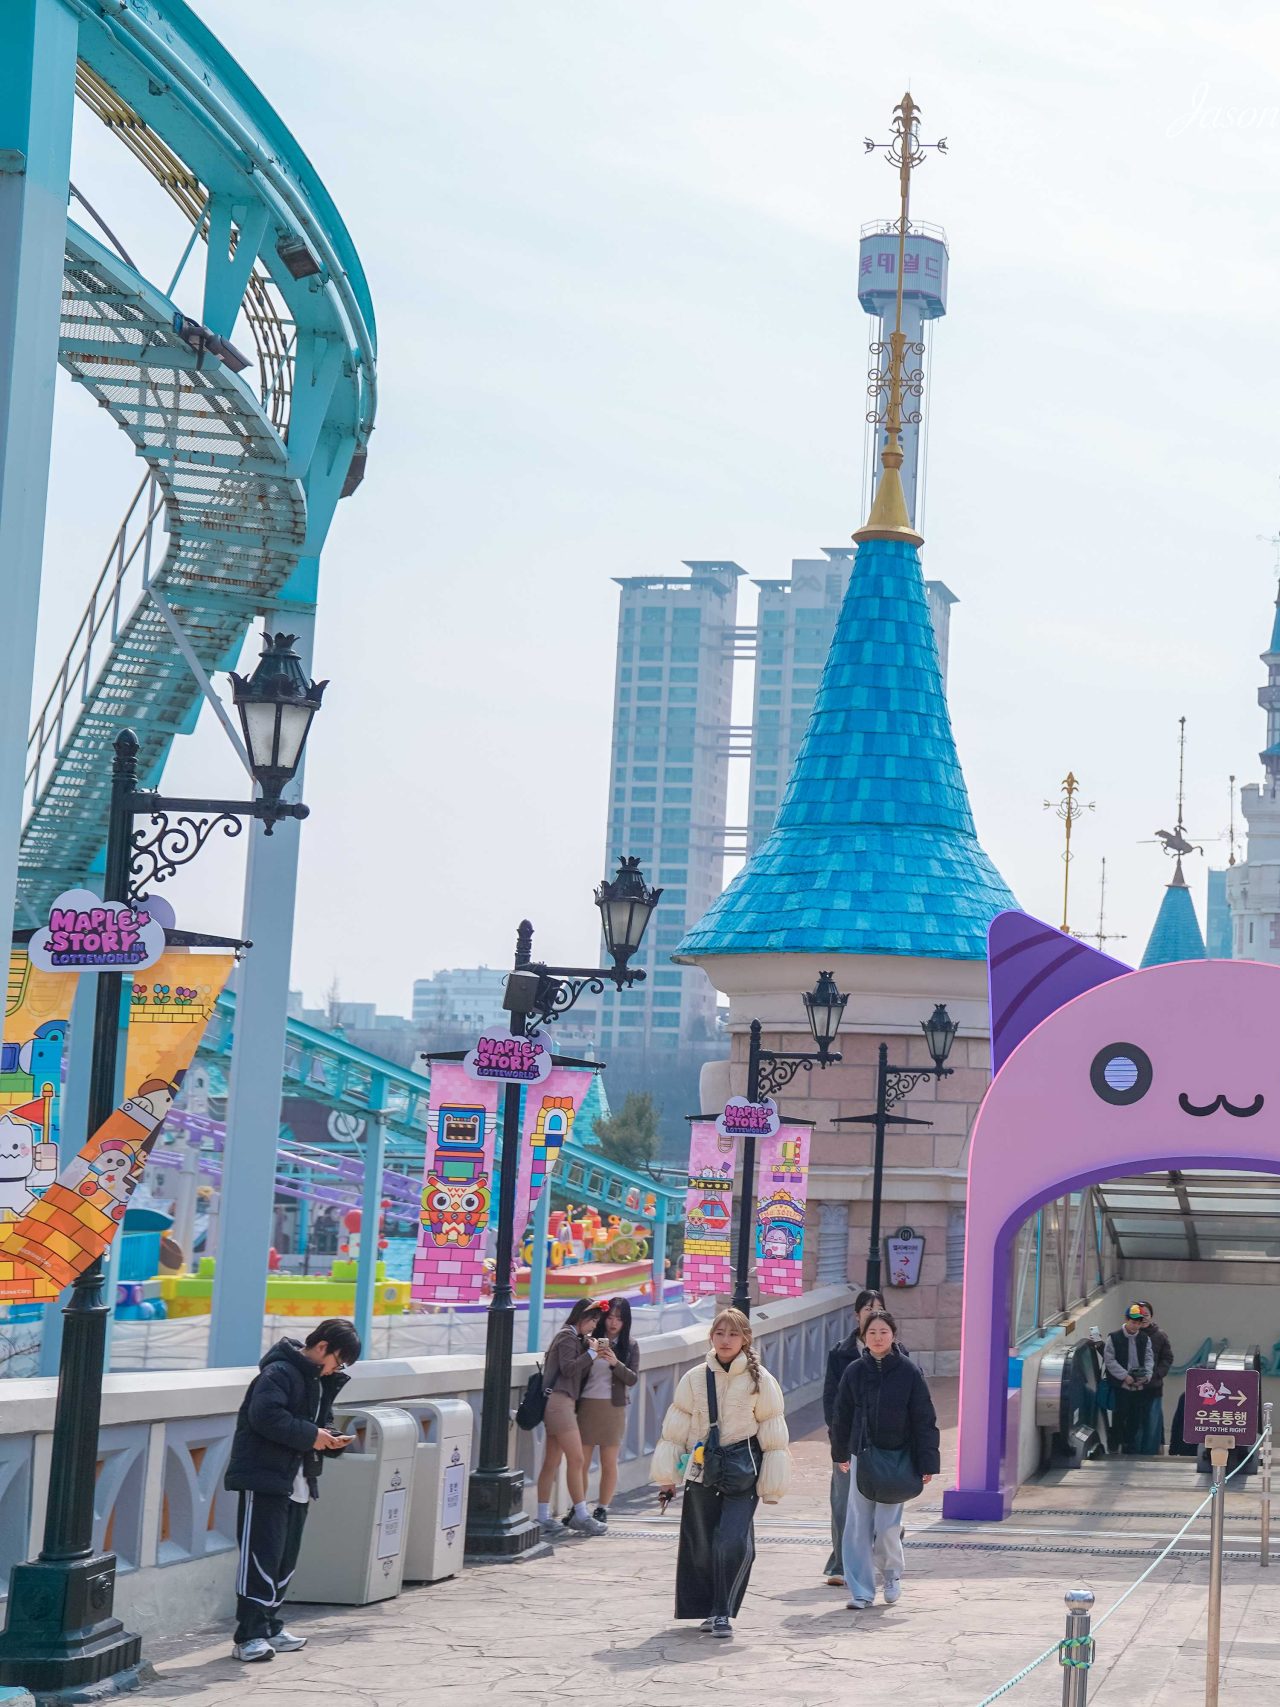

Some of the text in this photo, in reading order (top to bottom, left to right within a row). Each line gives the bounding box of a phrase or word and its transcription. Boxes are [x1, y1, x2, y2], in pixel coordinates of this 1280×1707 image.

[860, 253, 940, 279] 롯데월드
[50, 908, 139, 932] MAPLE
[52, 931, 144, 953] STORY IN
[52, 953, 139, 965] LOTTEWORLD
[478, 1037, 535, 1057] MAPLE
[479, 1053, 535, 1071] STORY
[477, 1068, 534, 1079] LOTTEWORLD
[725, 1105, 766, 1118] MAPLE
[726, 1116, 767, 1128] STORY
[1195, 1410, 1247, 1426] 우측통행
